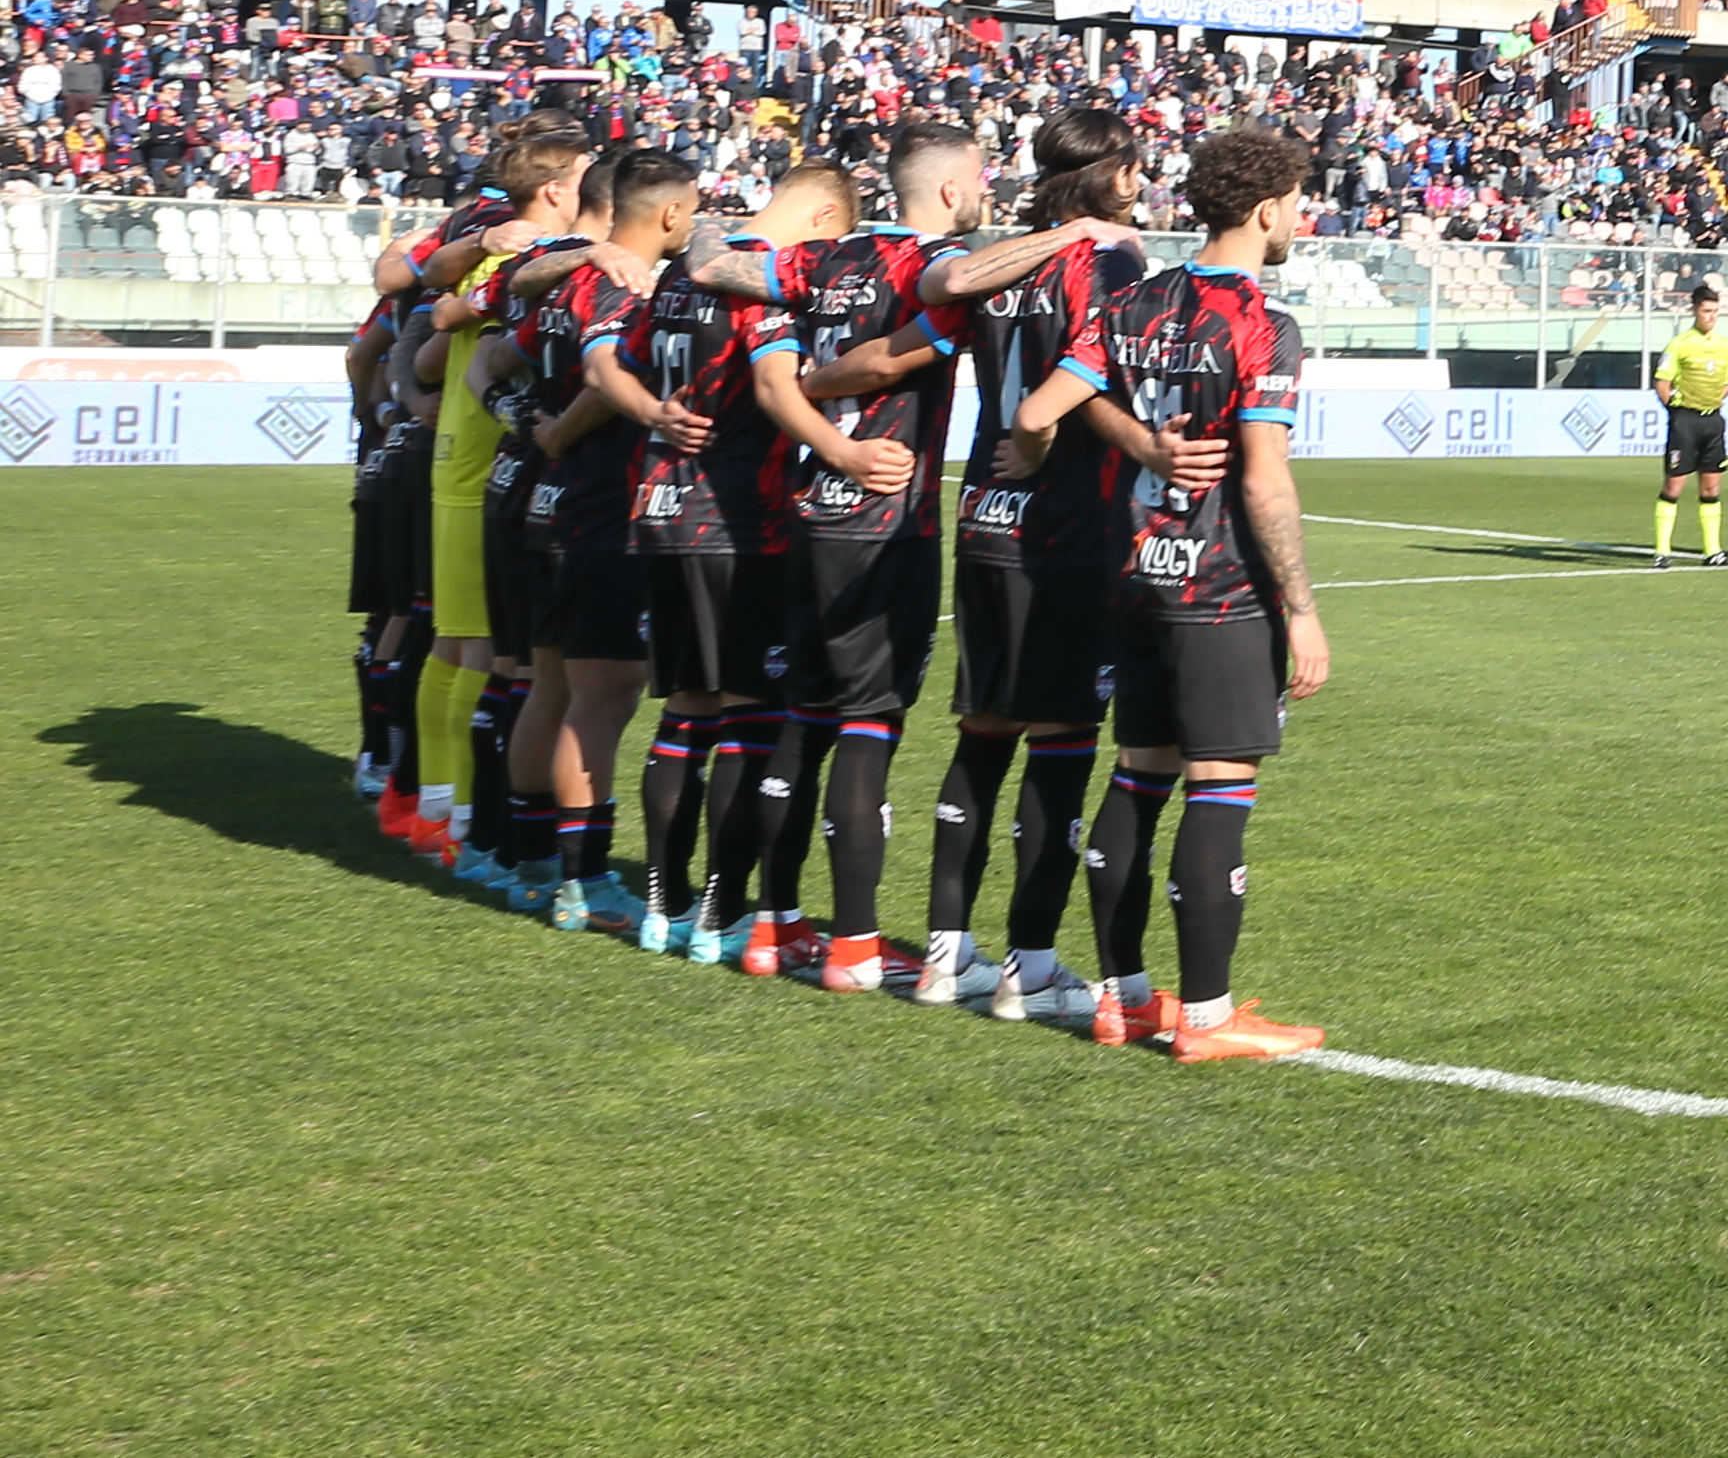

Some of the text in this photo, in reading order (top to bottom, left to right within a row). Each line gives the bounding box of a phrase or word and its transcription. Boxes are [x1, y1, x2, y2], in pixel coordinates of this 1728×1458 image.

[74, 383, 181, 445] celi
[1446, 391, 1513, 441] celi
[1619, 408, 1660, 440] ce
[1130, 533, 1208, 578] ILOGY
